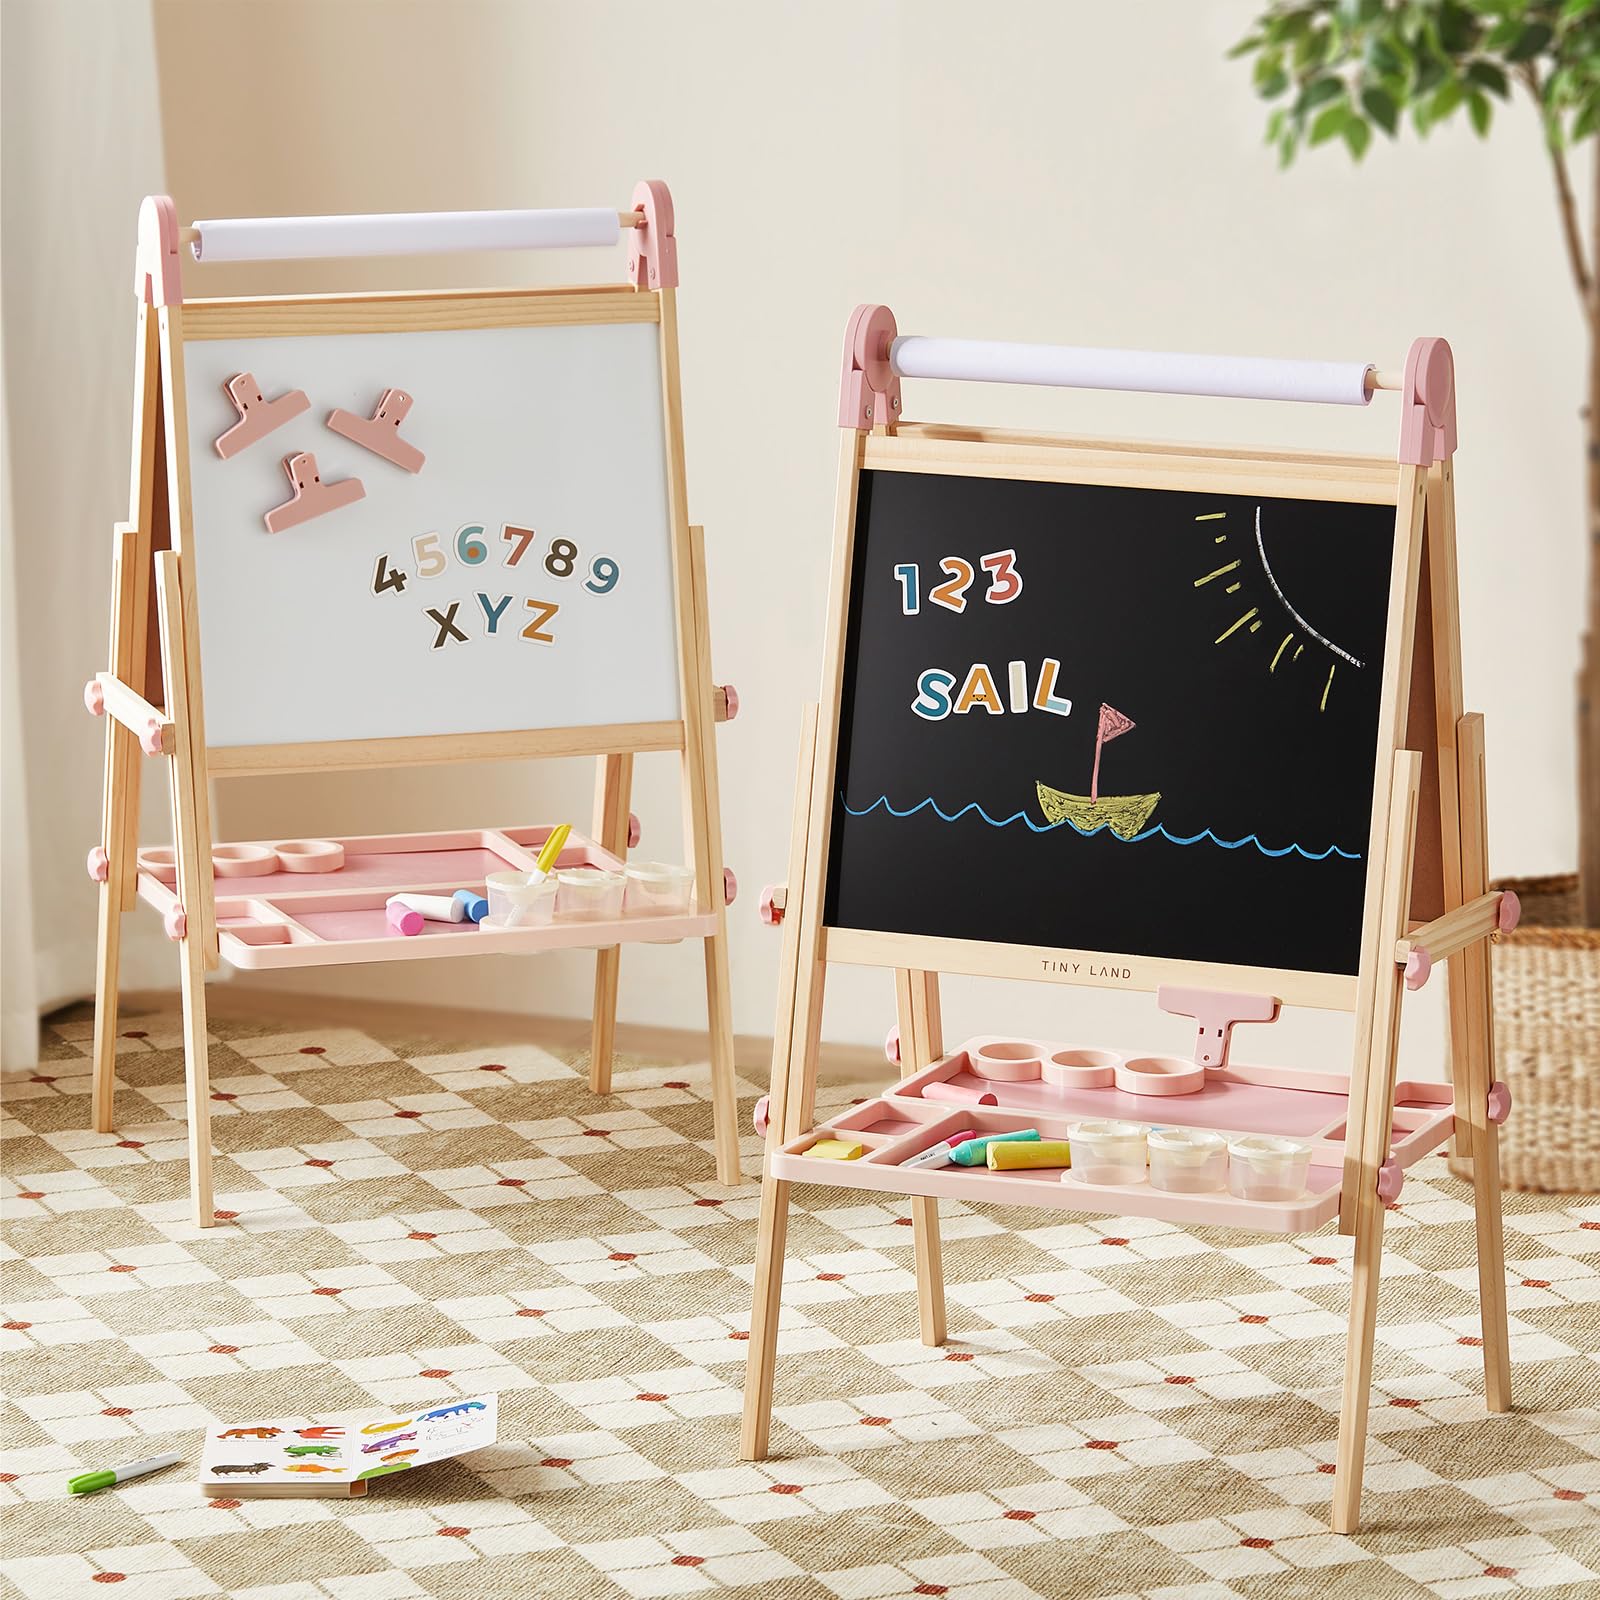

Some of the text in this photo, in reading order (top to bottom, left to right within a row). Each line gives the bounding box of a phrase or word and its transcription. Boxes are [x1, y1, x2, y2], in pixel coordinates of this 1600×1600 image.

[914, 660, 1069, 718] SAIL
[1042, 960, 1131, 979] TINY LAND
